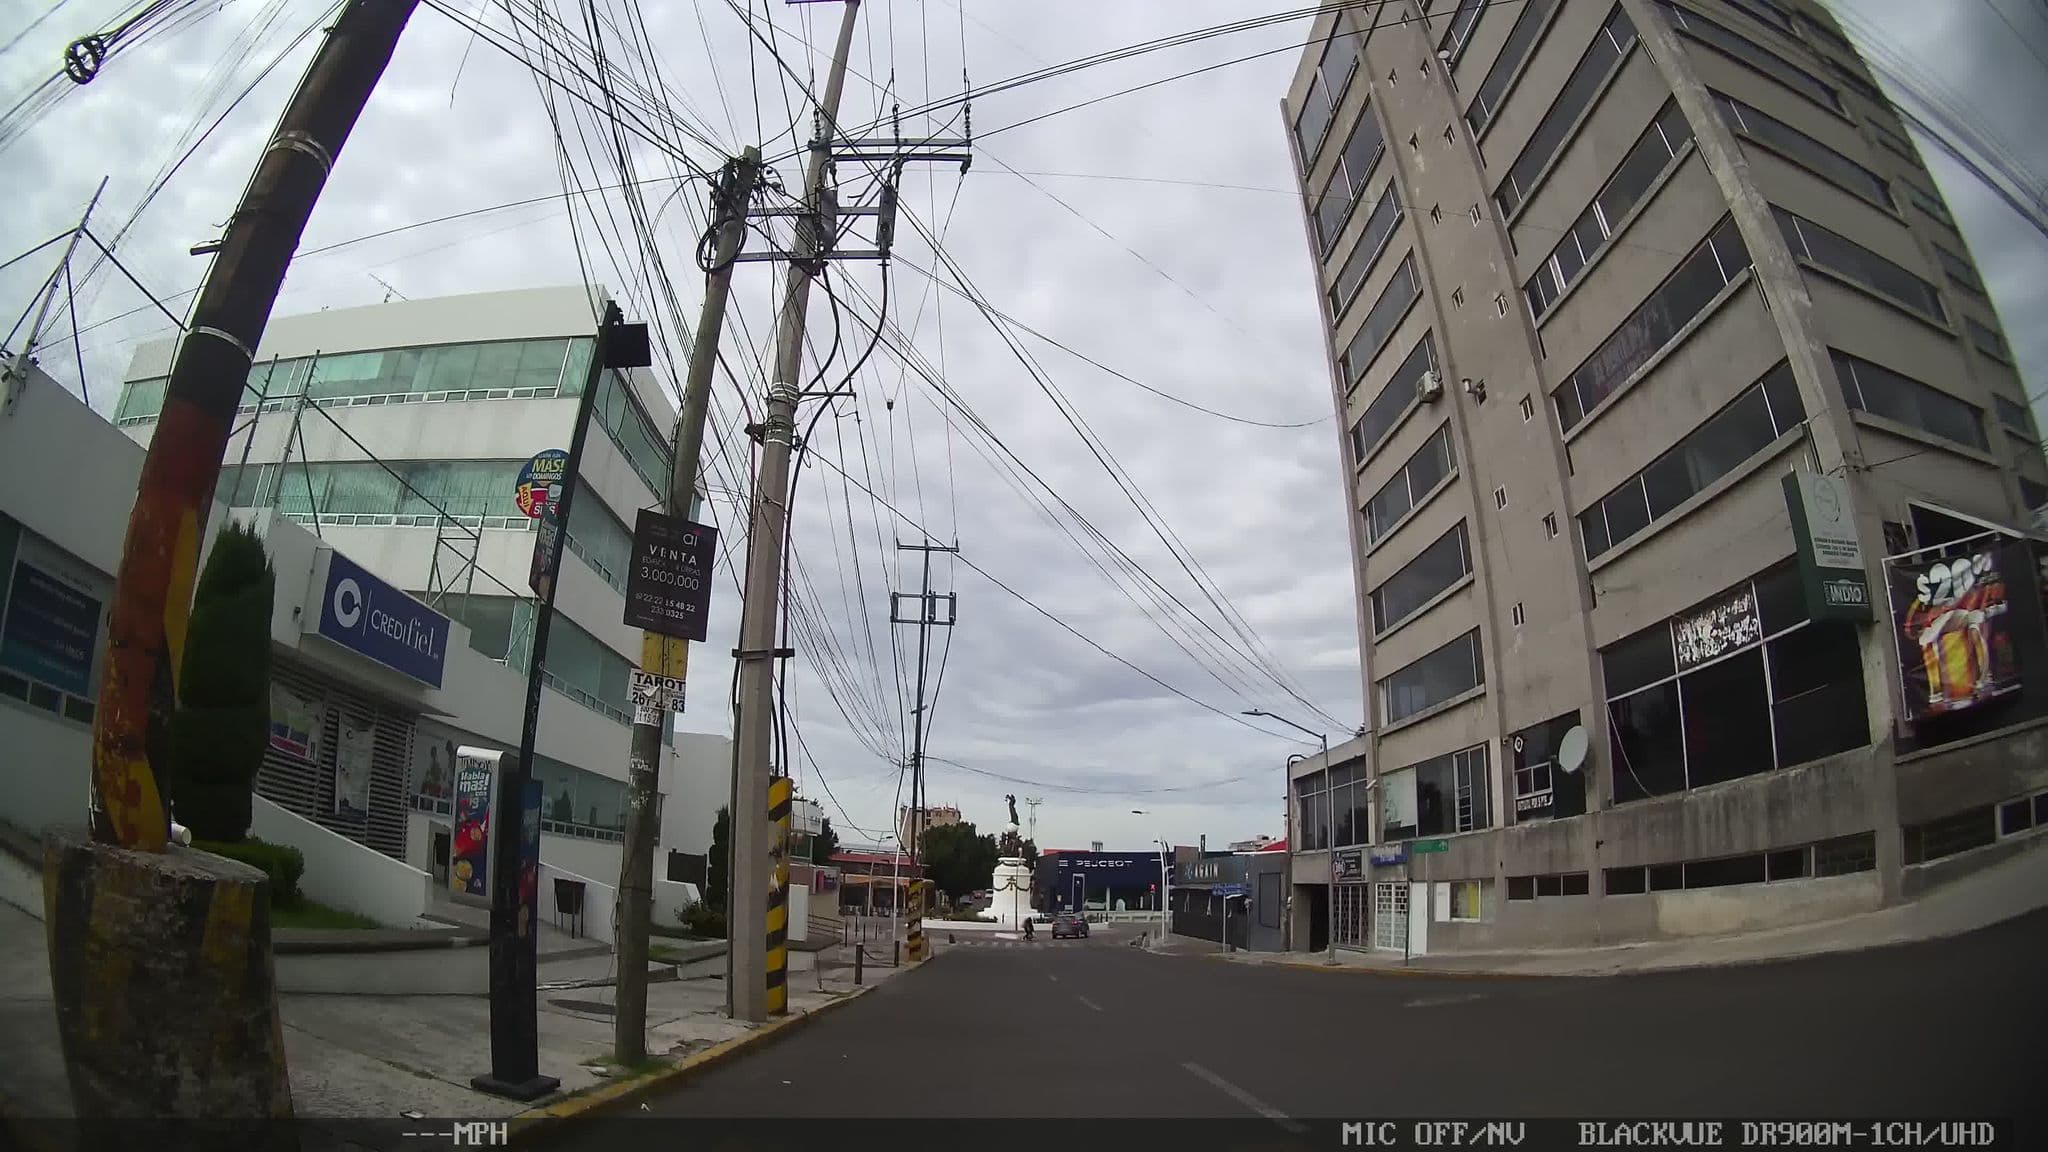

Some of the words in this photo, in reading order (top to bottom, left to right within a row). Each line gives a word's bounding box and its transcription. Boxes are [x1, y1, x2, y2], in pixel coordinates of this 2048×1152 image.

[648, 543, 697, 566] VENTA
[634, 672, 687, 692] TAROT
[672, 698, 686, 713] 83
[1194, 863, 1219, 879] AGAIN
